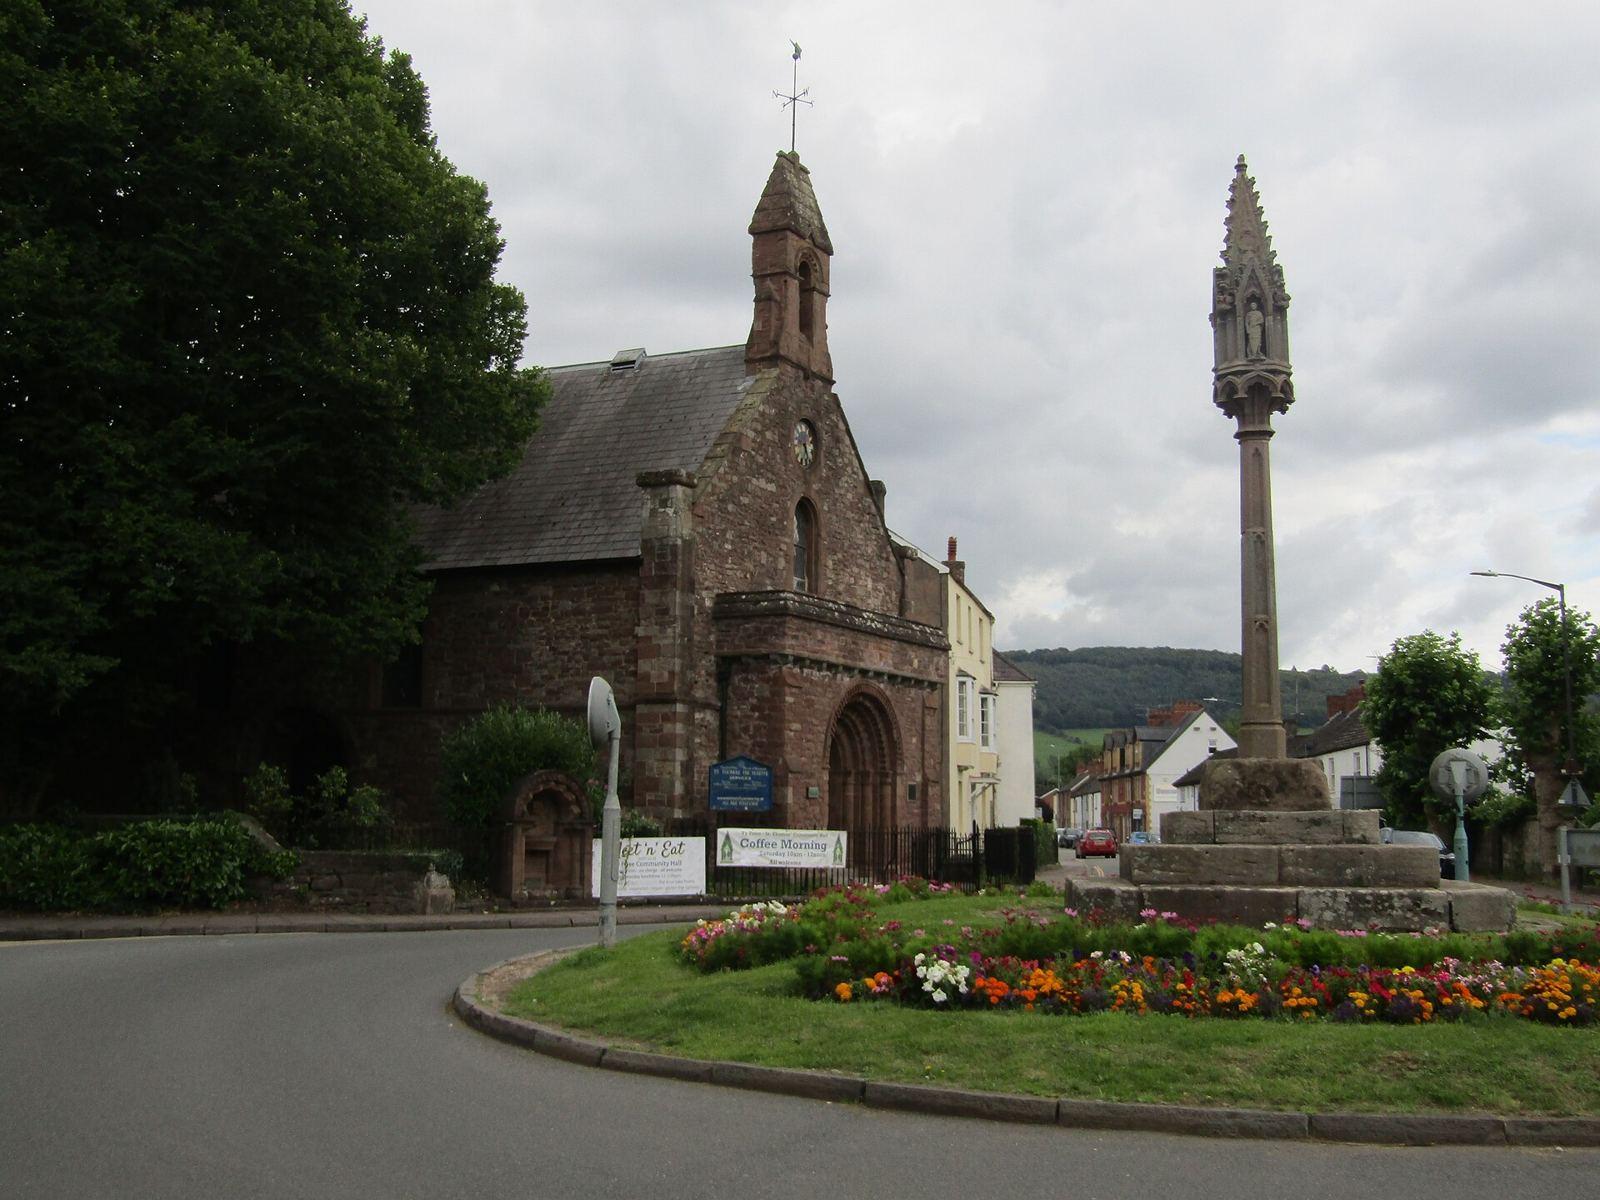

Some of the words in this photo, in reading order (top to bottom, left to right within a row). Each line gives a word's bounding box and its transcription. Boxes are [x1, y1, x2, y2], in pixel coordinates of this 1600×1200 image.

[619, 841, 641, 857] eet
[661, 840, 686, 858] Eat
[740, 838, 778, 848] Coffee
[781, 839, 828, 852] Morning
